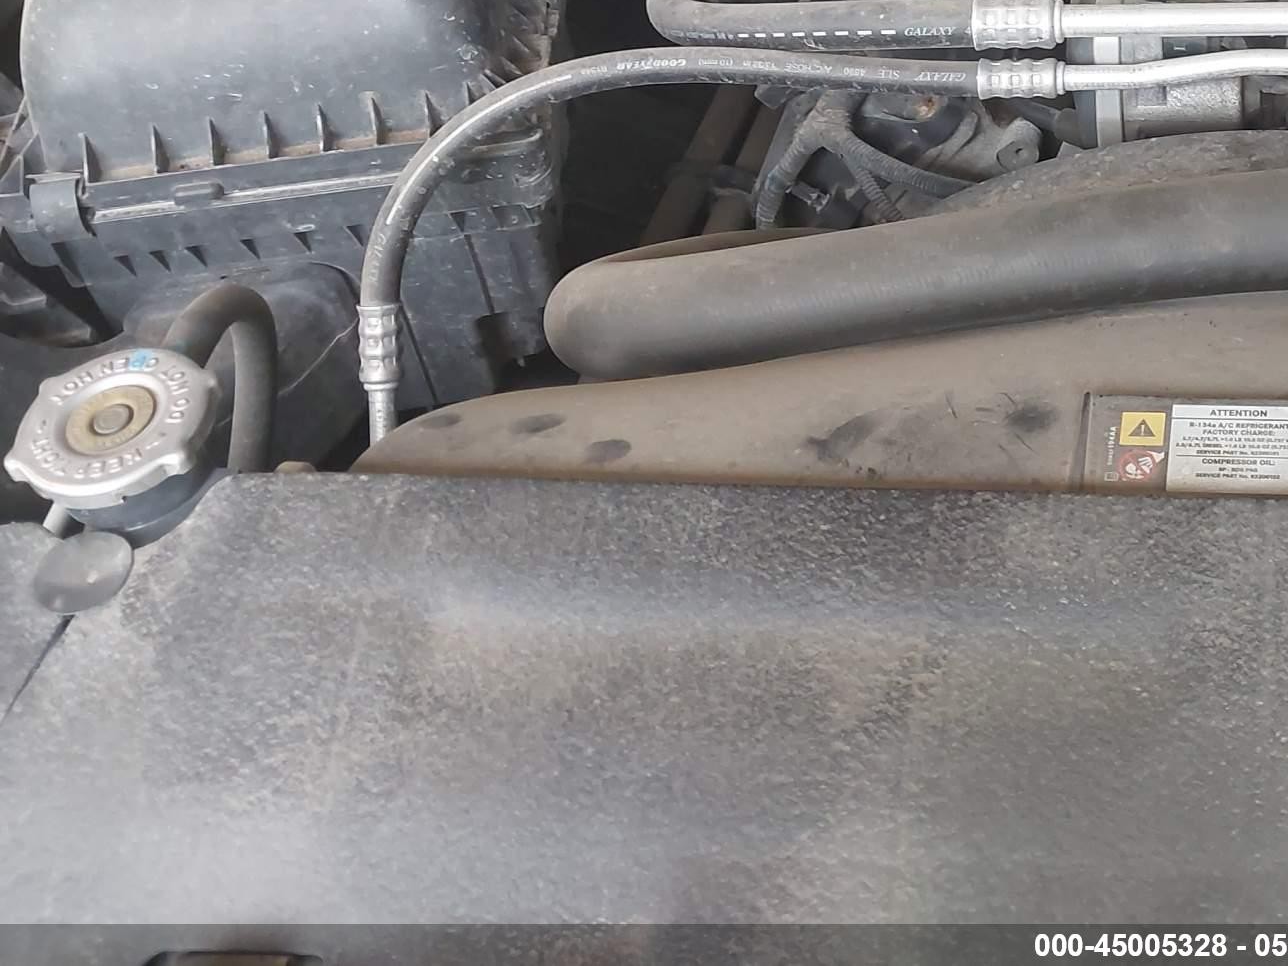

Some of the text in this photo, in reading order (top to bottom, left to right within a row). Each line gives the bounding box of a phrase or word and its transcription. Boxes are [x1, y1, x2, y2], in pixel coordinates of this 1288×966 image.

[904, 26, 956, 37] GALAXY
[616, 56, 687, 70] GOODYEAR
[784, 62, 811, 74] HOSE
[879, 66, 900, 80] SLE
[914, 70, 966, 82] GALAXY
[98, 355, 160, 376] OPEN
[50, 371, 93, 405] HOT
[165, 396, 191, 426] DO
[1210, 409, 1268, 418] ATTENTION
[1202, 458, 1276, 466] COMPRESSOR OIL:
